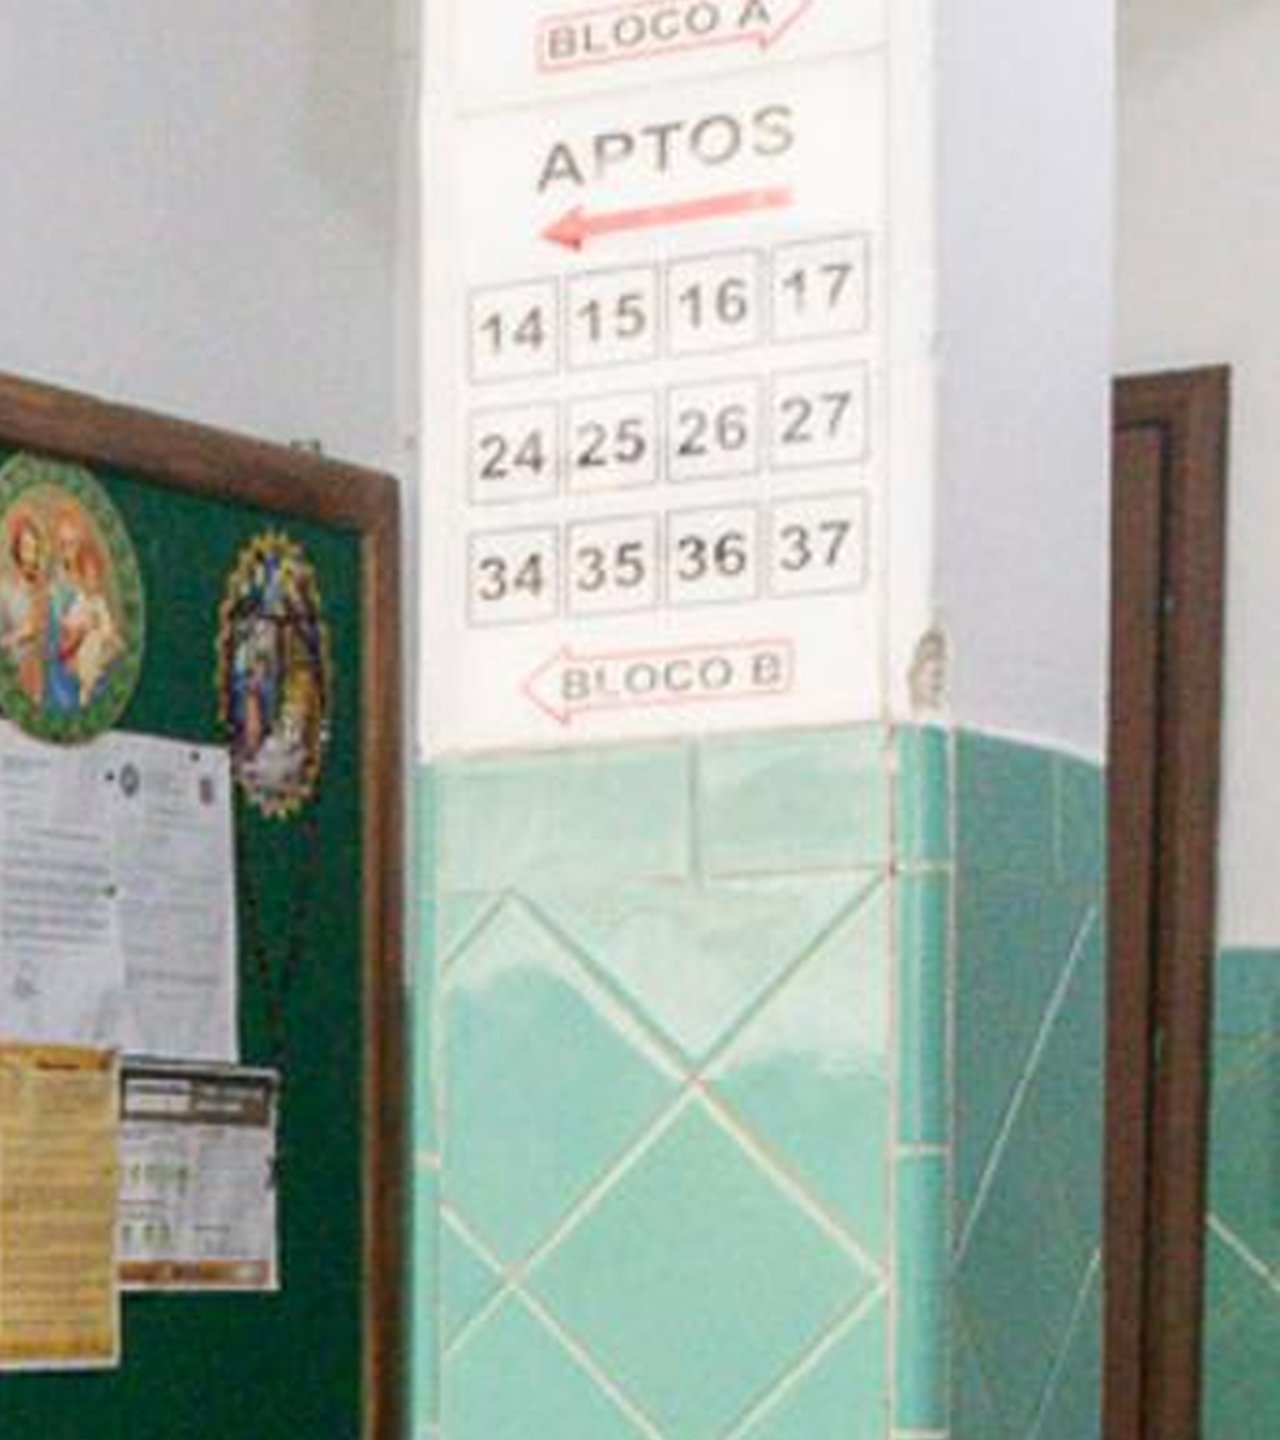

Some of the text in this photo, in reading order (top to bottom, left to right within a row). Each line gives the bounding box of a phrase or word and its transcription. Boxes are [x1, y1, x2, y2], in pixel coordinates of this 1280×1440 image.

[547, 3, 719, 62] BLOCO
[537, 105, 796, 194] APTOS
[678, 276, 747, 329] 16
[781, 262, 853, 312] 17
[480, 307, 546, 355] 14
[577, 294, 647, 342] 15
[677, 404, 747, 457] 26
[780, 391, 852, 444] 27
[479, 431, 546, 480] 24
[576, 419, 647, 469] 25
[575, 541, 647, 593] 35
[676, 530, 747, 583] 36
[779, 520, 852, 571] 37
[478, 553, 546, 603] 34
[561, 652, 782, 703] BLOCO B
